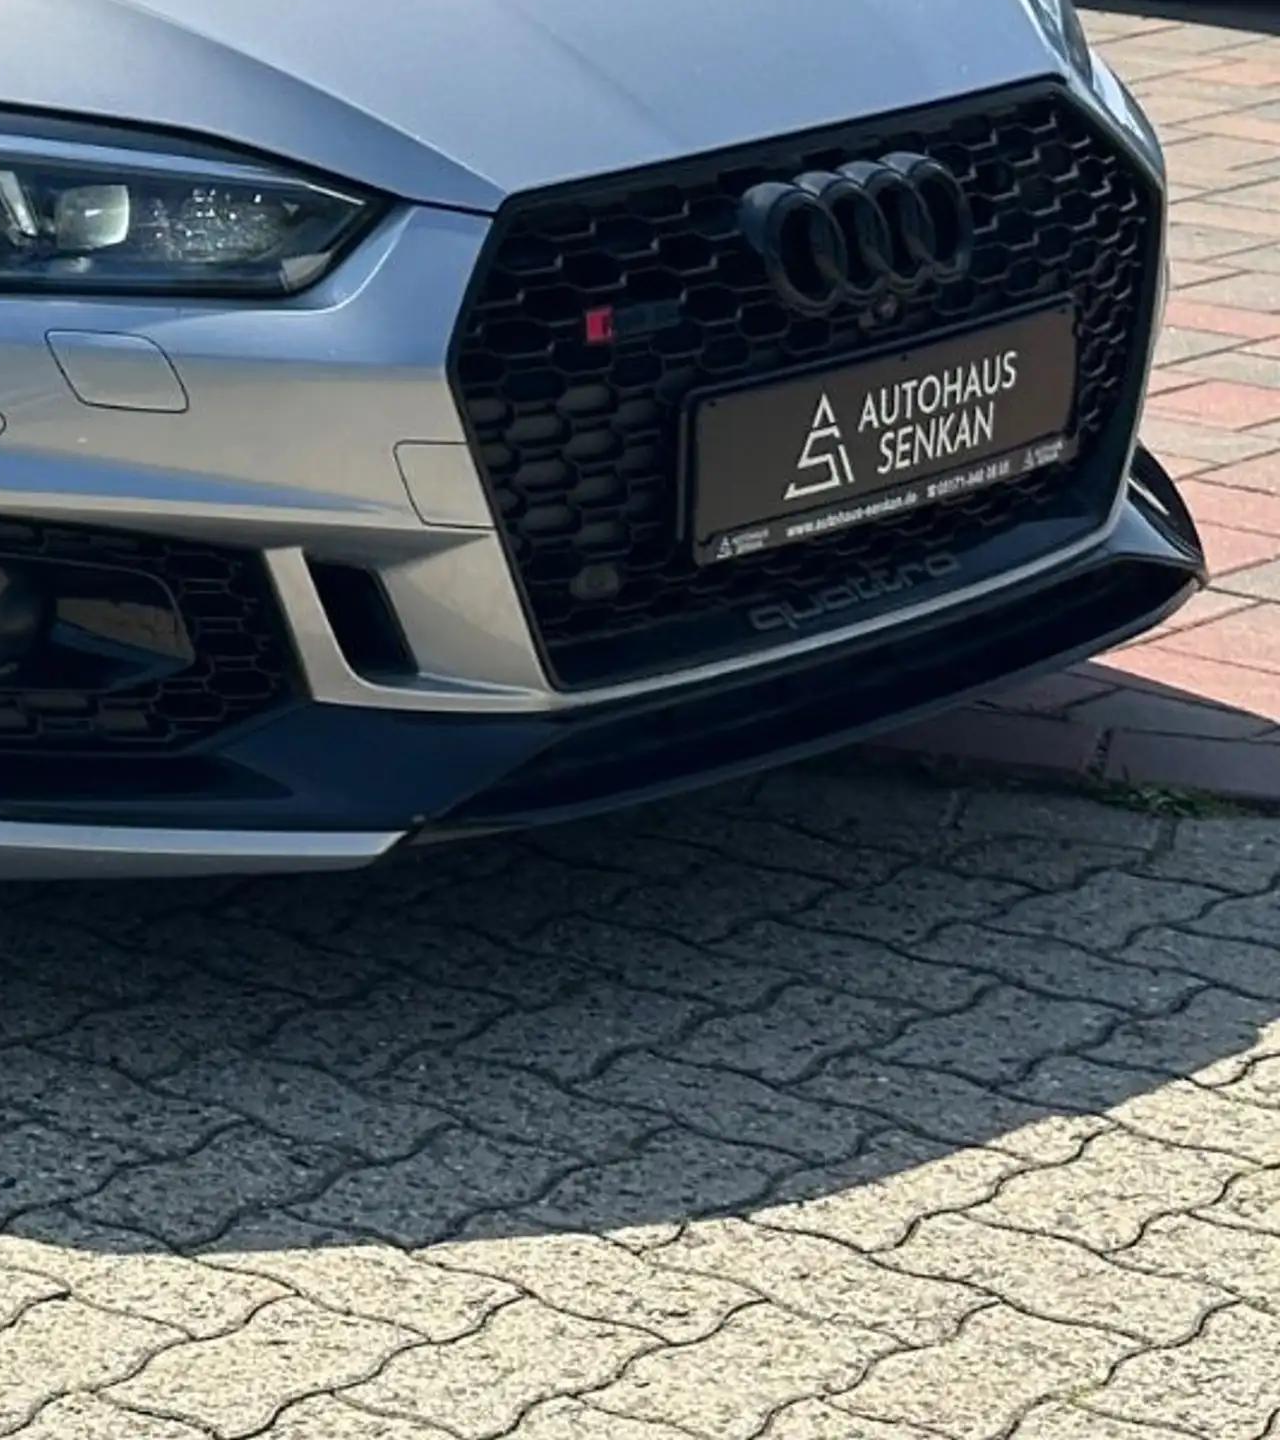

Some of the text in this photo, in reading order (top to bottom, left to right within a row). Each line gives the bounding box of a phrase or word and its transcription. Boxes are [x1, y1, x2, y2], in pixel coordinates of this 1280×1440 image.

[857, 350, 1018, 433] AUTOHAUS
[876, 401, 995, 476] SENKAN
[747, 550, 963, 631] quattro
